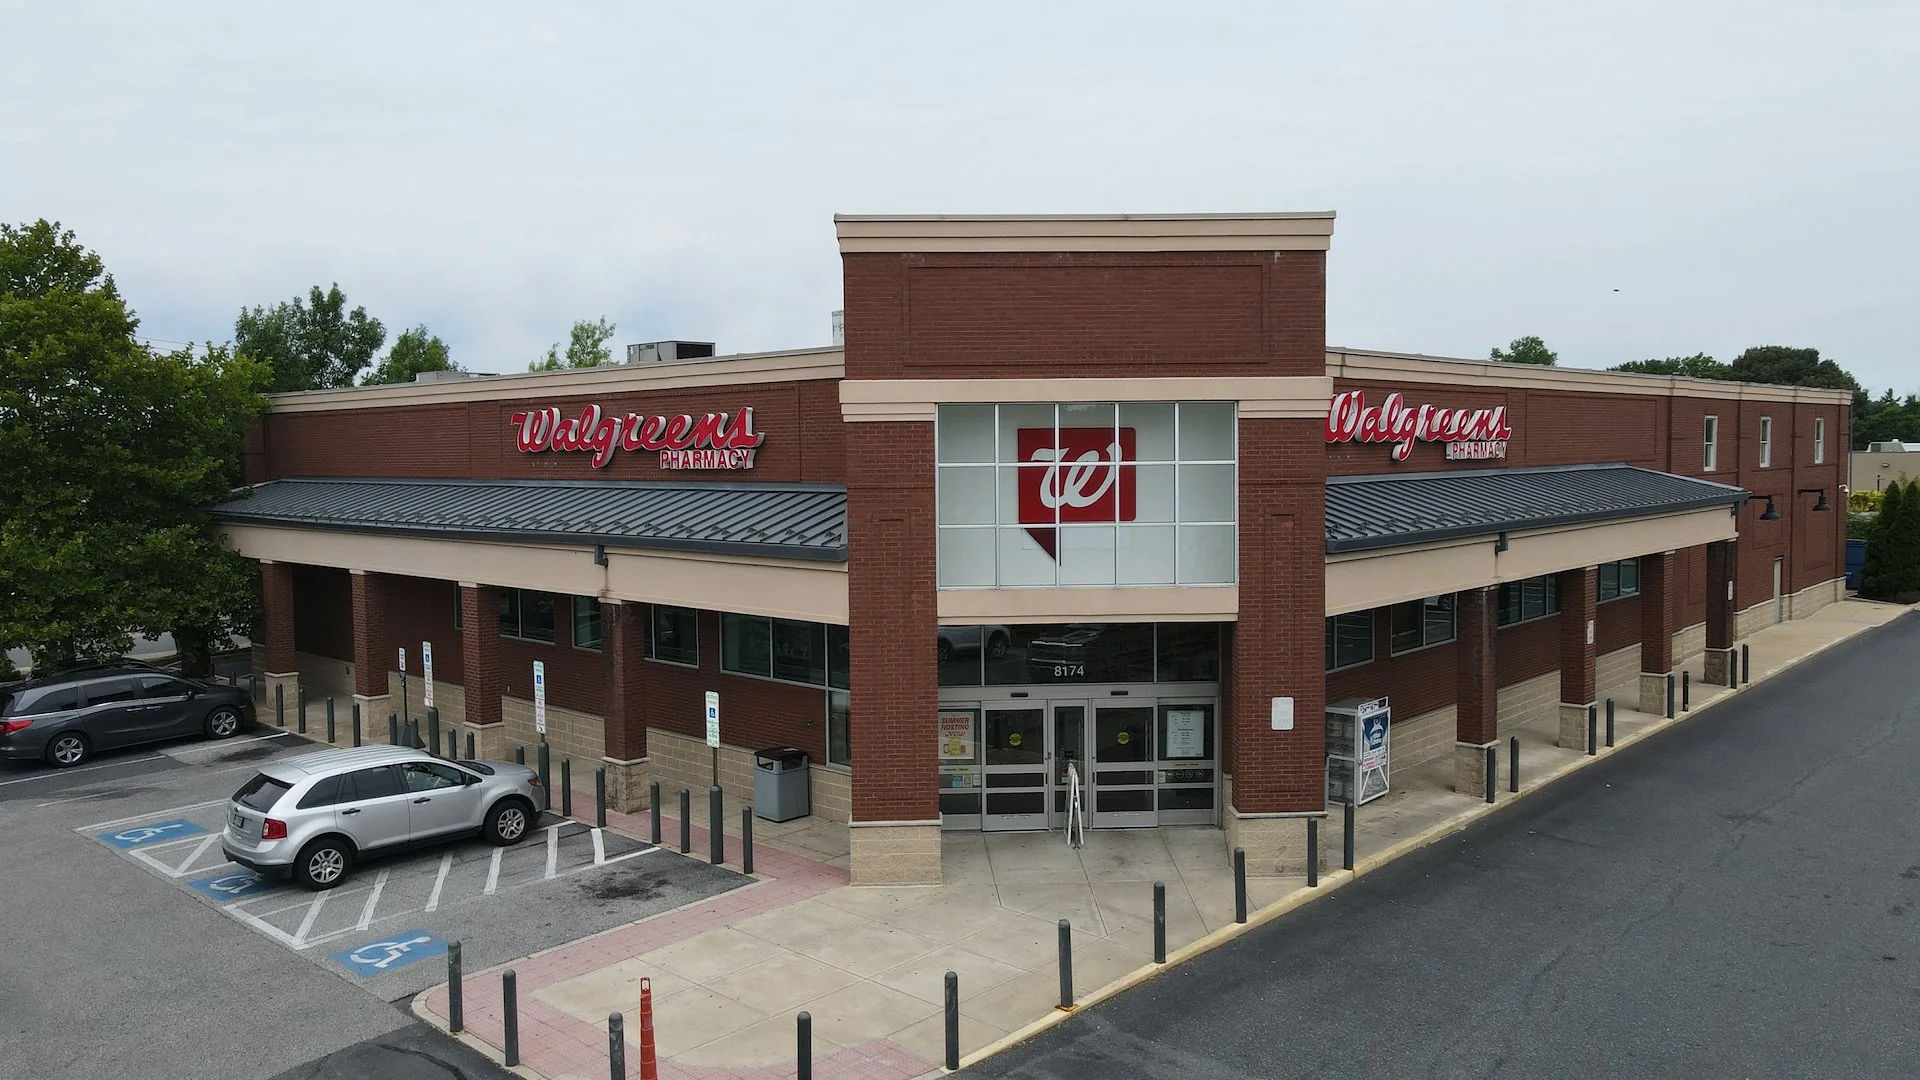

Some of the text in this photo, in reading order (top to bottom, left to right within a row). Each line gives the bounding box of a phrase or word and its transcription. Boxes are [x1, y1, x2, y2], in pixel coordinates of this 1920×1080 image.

[1325, 389, 1512, 461] Walgreens
[511, 403, 765, 469] Walgreens
[659, 449, 755, 469] PHARMACY
[1447, 442, 1508, 459] PHARMACY
[1054, 665, 1085, 677] 8174
